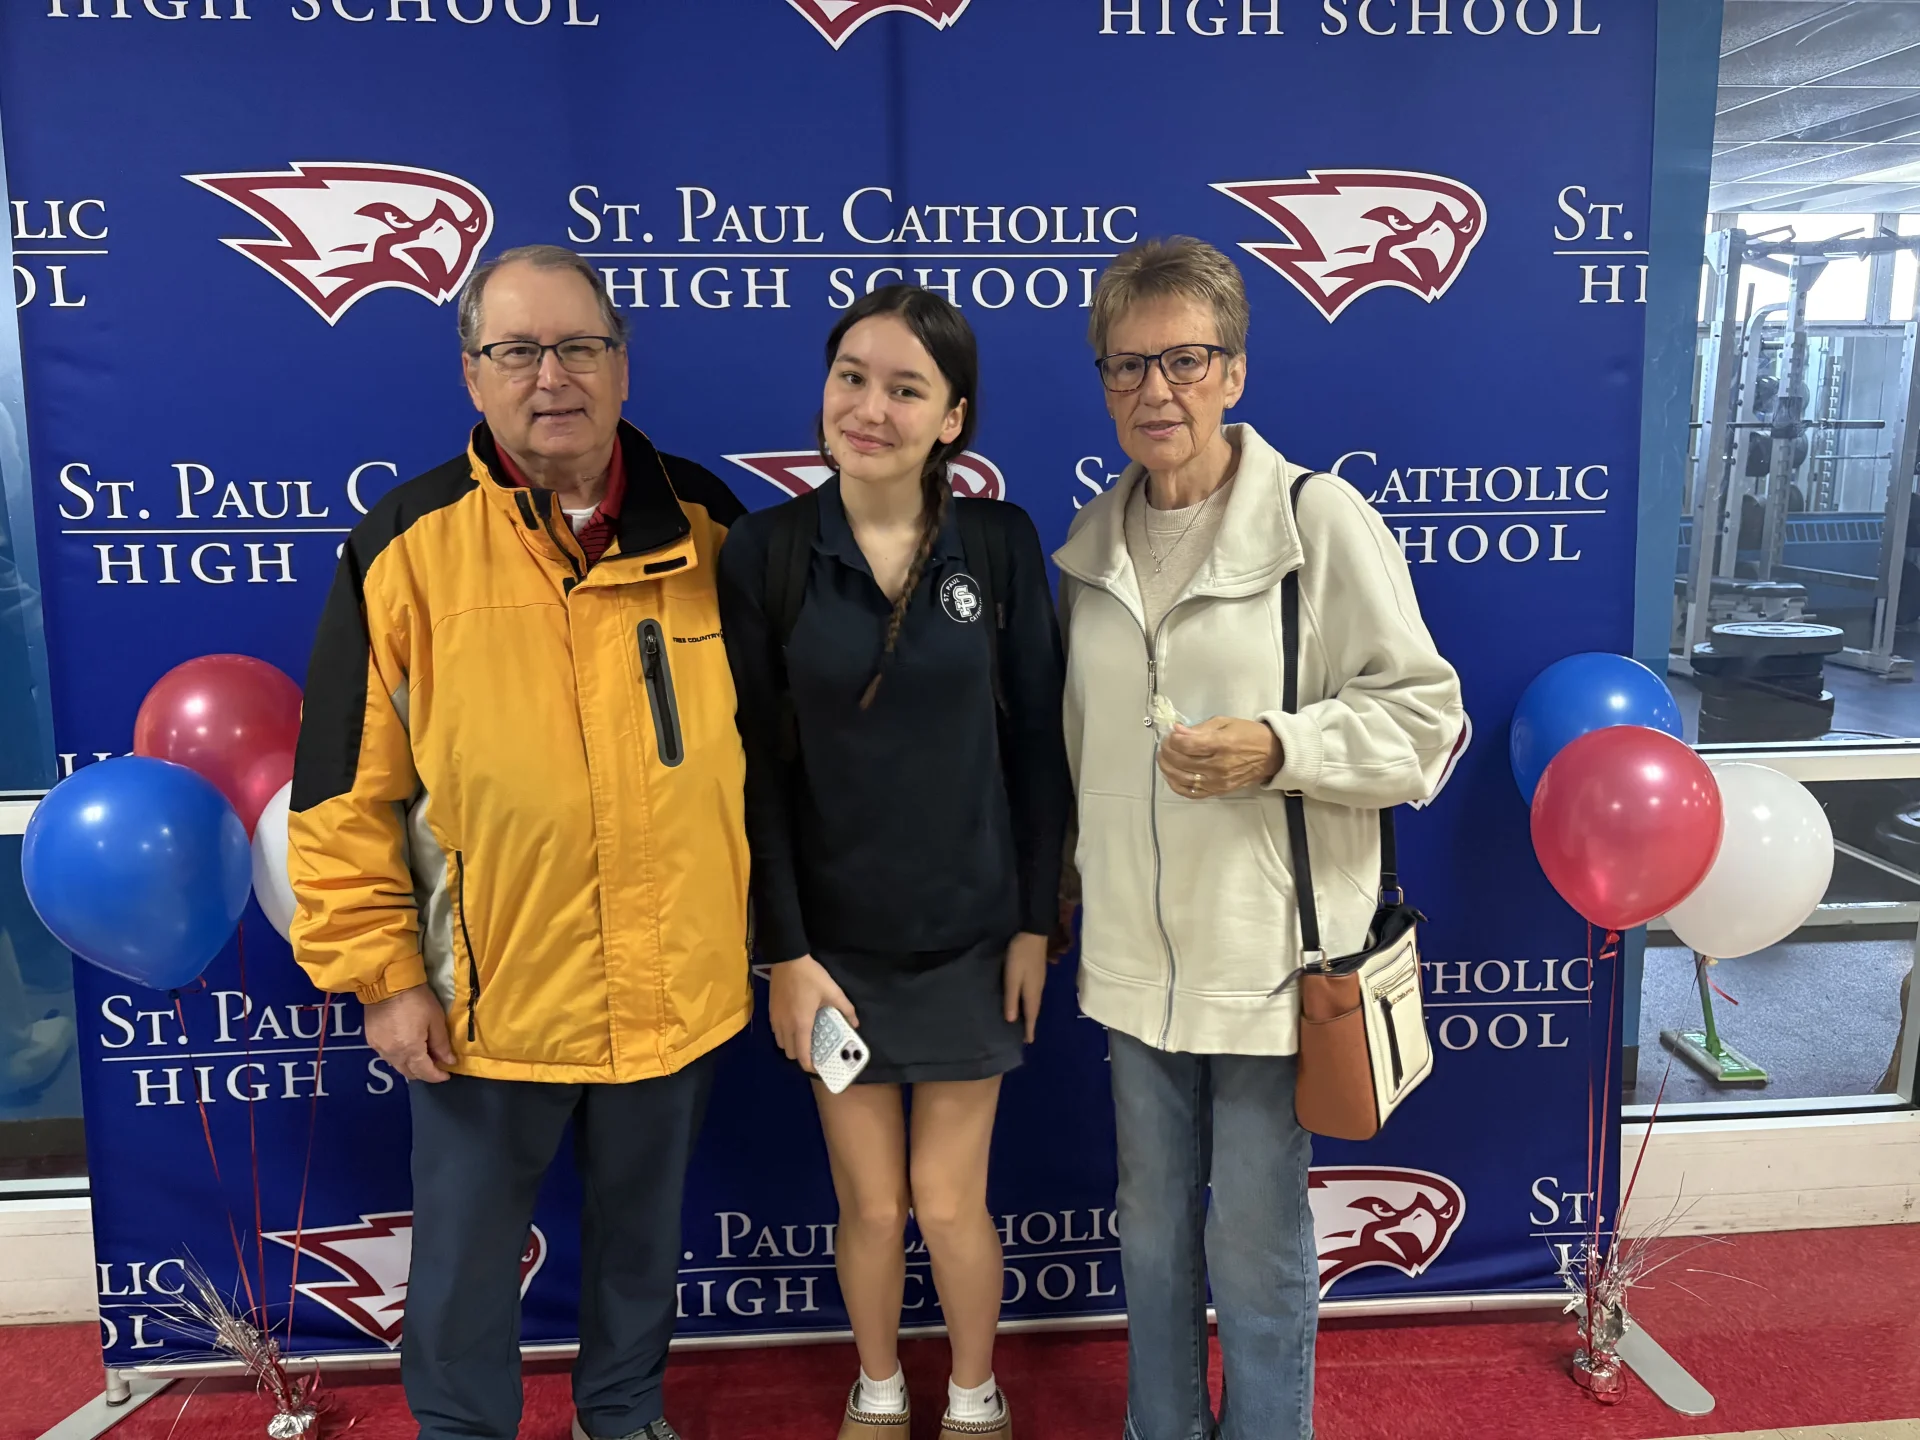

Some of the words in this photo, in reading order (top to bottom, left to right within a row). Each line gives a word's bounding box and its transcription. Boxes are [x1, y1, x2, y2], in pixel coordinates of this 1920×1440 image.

[1098, 0, 1285, 36] HIGH
[1320, 0, 1602, 36] SCHOOL
[567, 185, 654, 243] ST.
[676, 186, 824, 243] PAUL
[842, 186, 1139, 244] CATHOLIC
[1554, 185, 1634, 241] ST.
[598, 266, 792, 309] HIGH
[58, 462, 151, 520] ST.
[171, 463, 329, 519] PAUL
[92, 542, 298, 584] HIGH
[1393, 523, 1581, 564] HOOL
[945, 577, 960, 591] PAUL
[687, 632, 720, 643] COUNTRY
[100, 995, 189, 1049] ST.
[211, 990, 362, 1043] PAUL
[132, 1060, 329, 1107] HIGH
[1529, 1176, 1605, 1226] ST.
